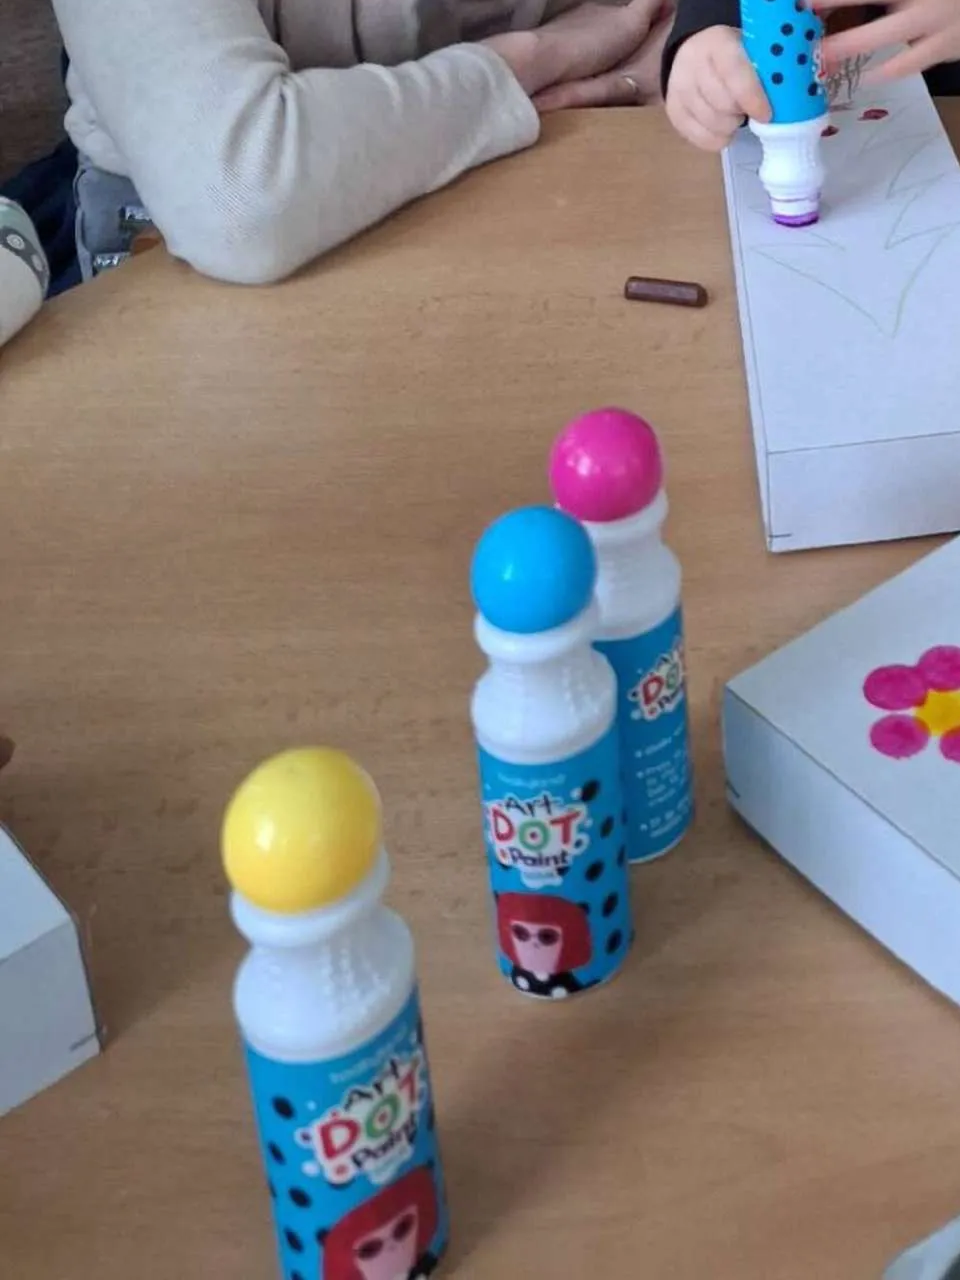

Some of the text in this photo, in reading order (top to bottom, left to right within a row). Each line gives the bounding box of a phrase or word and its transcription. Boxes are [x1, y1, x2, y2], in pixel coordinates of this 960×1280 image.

[505, 794, 554, 817] Art
[491, 806, 580, 852] DOT
[508, 846, 569, 868] Paint
[344, 1058, 400, 1113] Art
[319, 1057, 419, 1162] DOT
